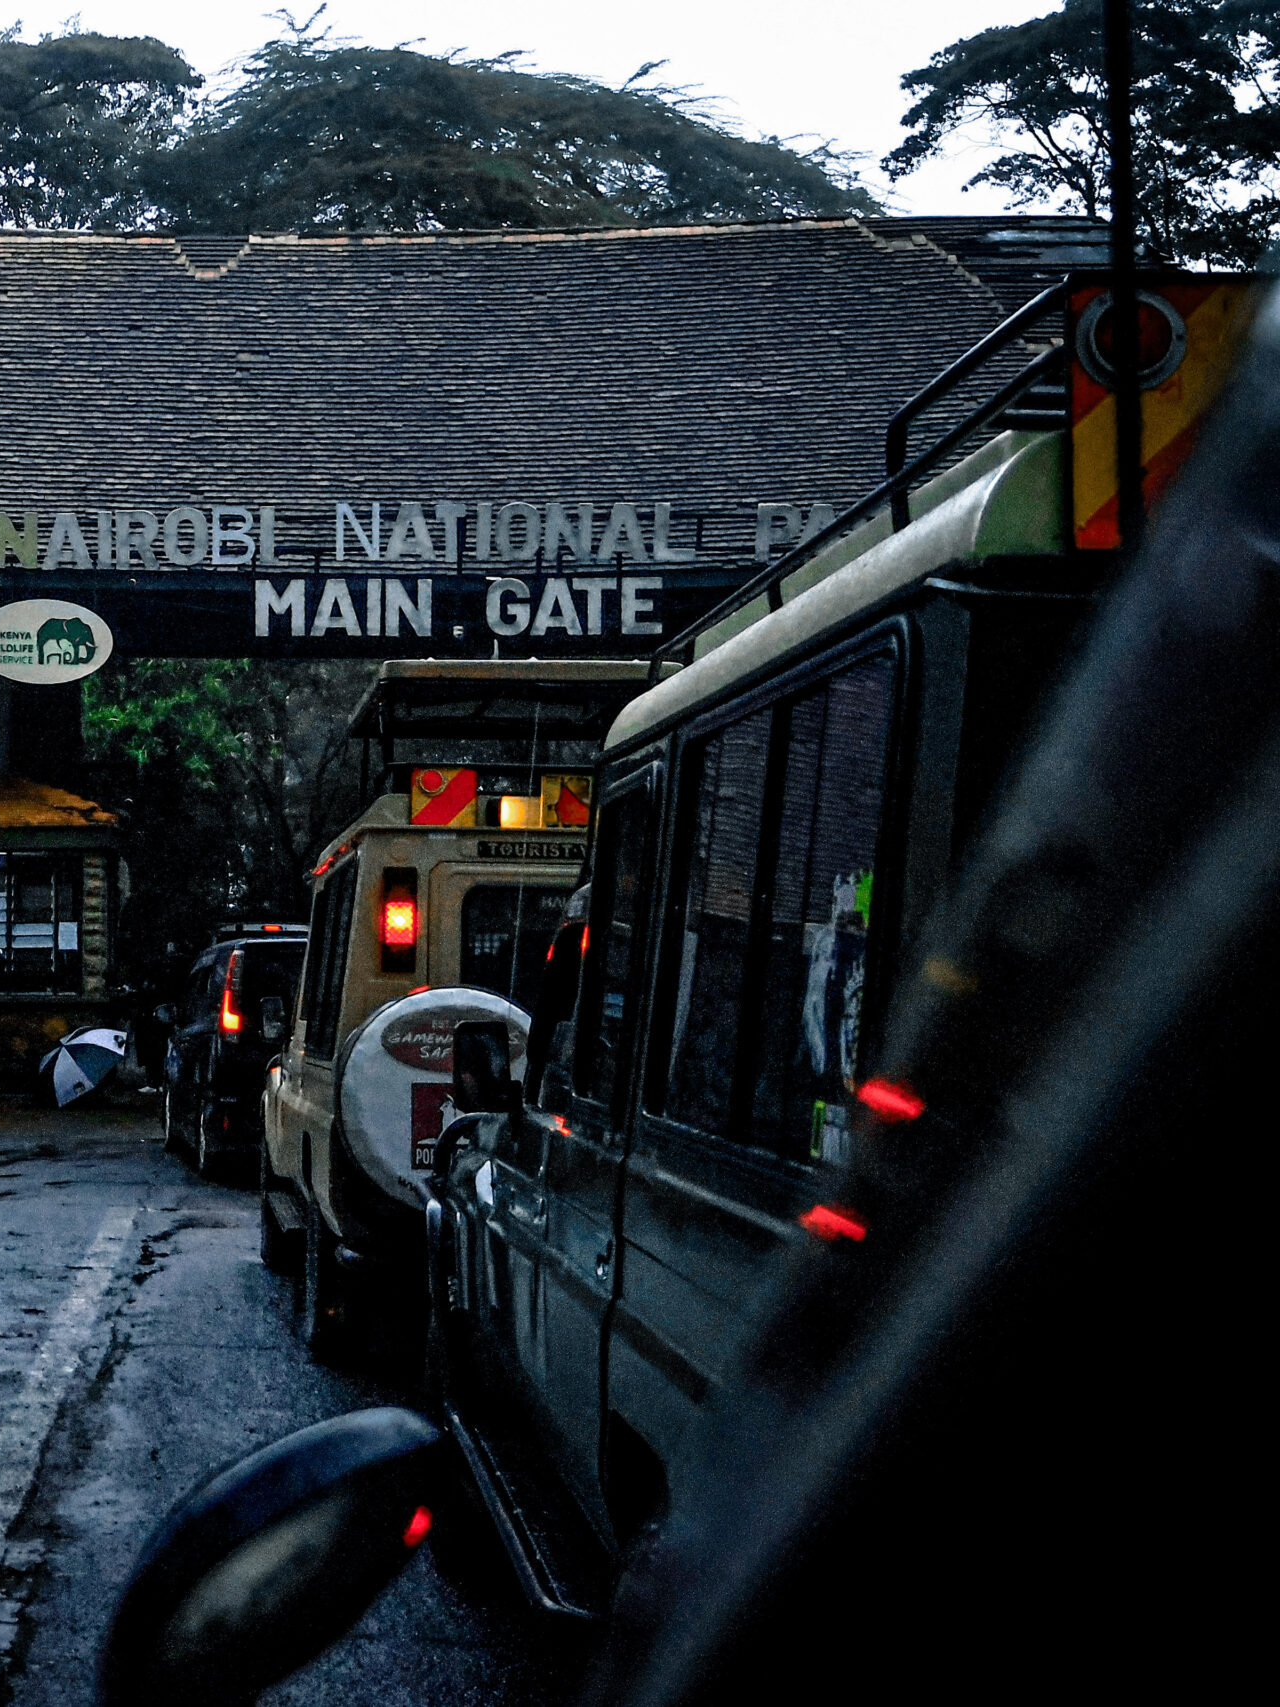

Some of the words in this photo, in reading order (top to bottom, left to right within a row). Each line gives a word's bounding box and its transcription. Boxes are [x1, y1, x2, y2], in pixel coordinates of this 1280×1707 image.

[336, 502, 696, 561] NATIONAL
[254, 578, 432, 637] MAIN
[486, 577, 663, 636] GATE
[0, 631, 31, 640] KENYA
[488, 842, 573, 857] TOURIST
